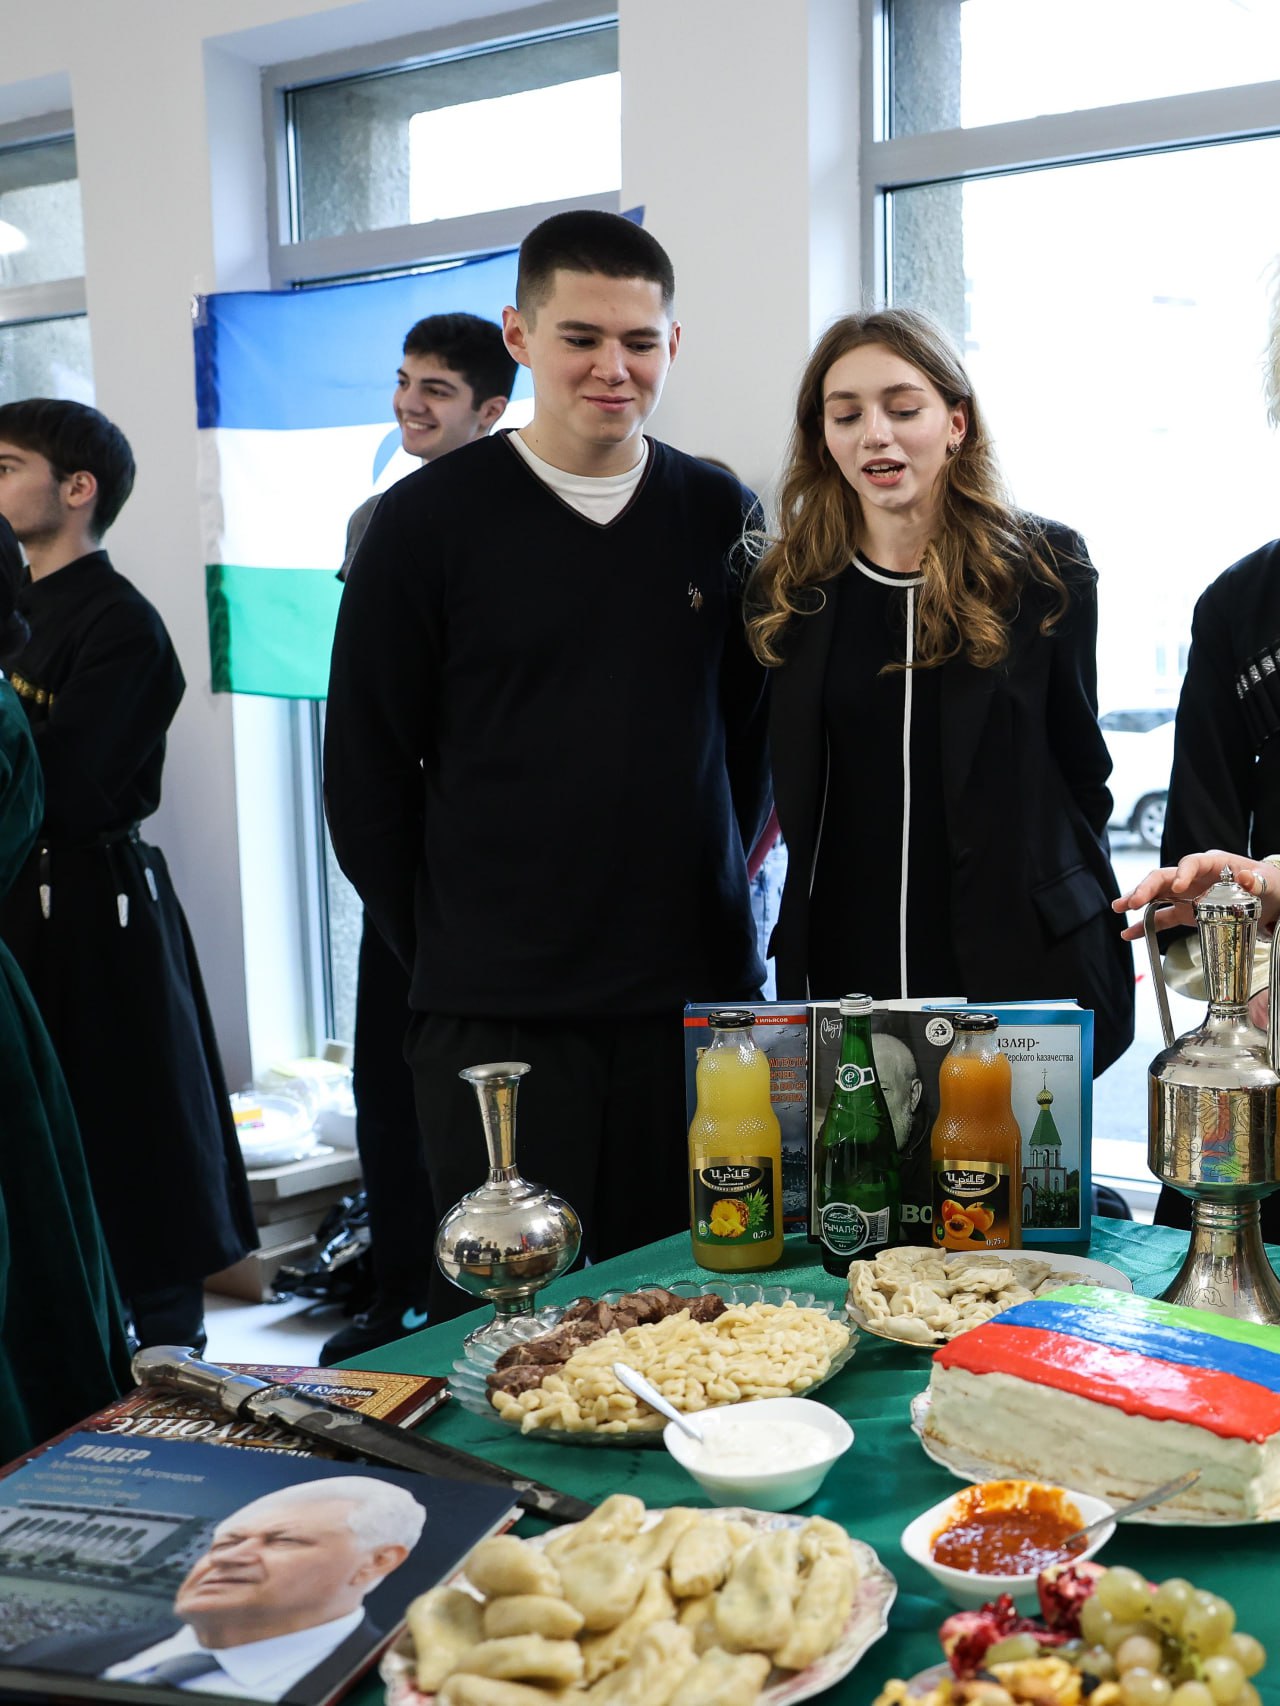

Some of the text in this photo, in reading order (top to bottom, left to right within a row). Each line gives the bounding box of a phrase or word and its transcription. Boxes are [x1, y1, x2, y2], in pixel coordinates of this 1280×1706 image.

[1036, 1052, 1074, 1062] казачества
[314, 1384, 374, 1397] Курбанов
[65, 1444, 152, 1463] ЛИДЕР
